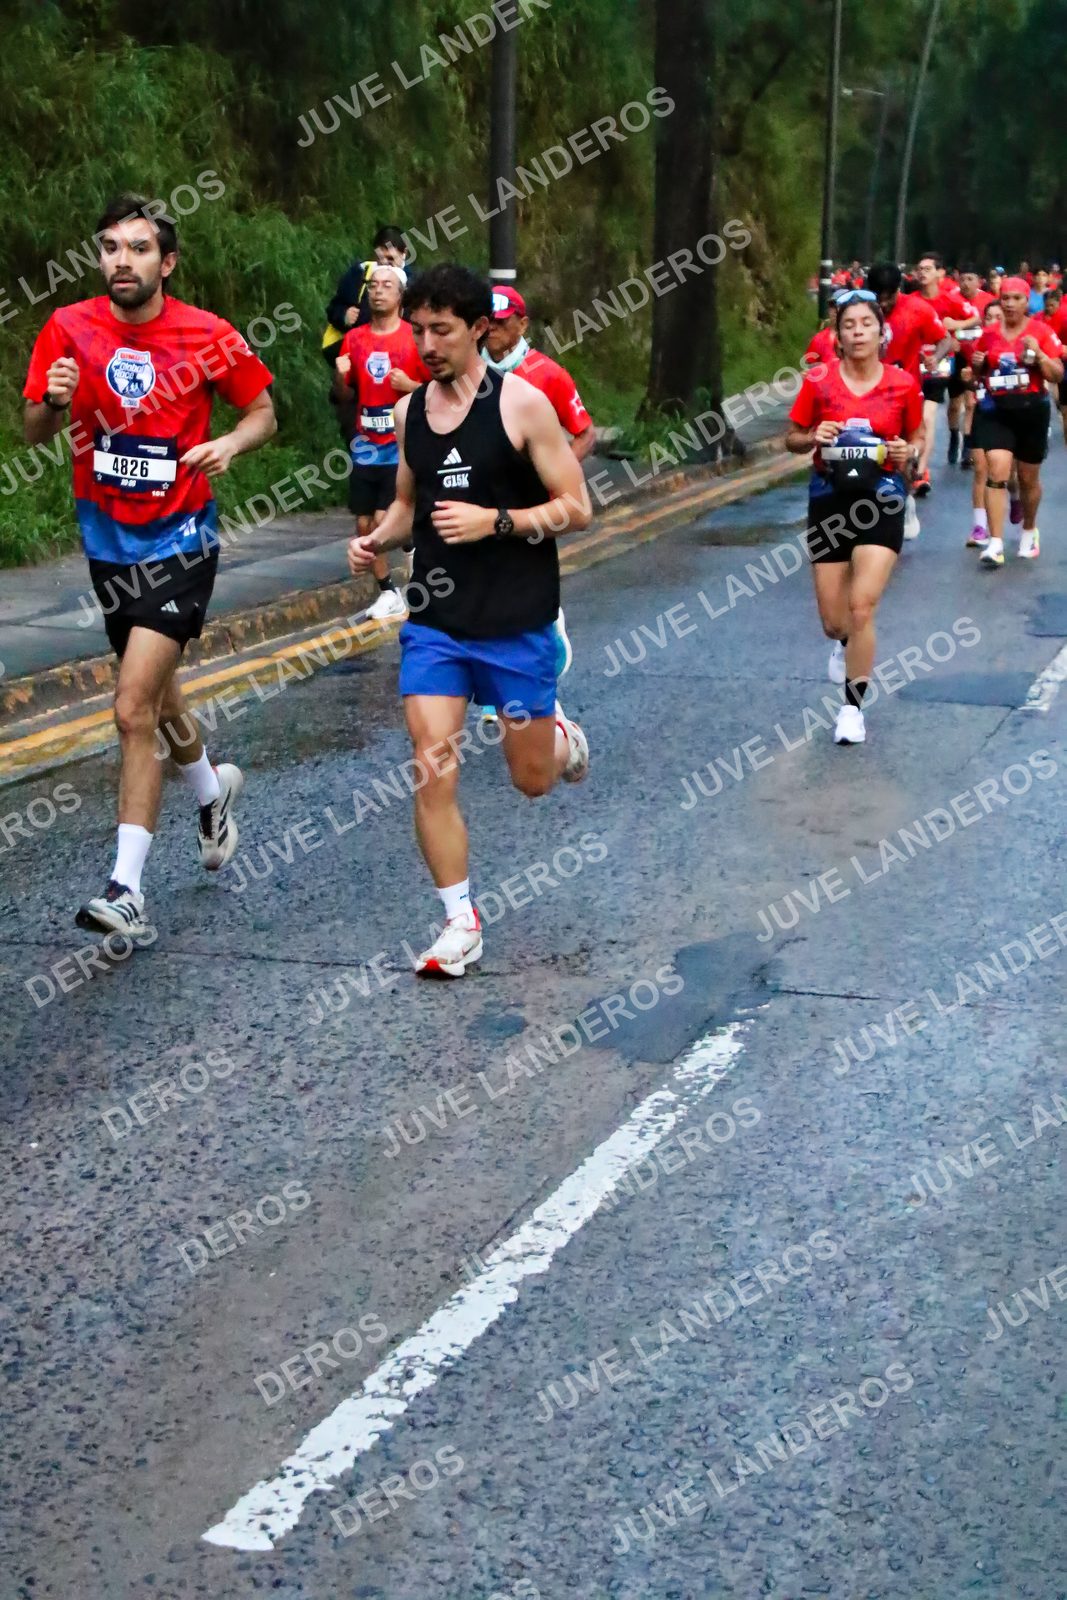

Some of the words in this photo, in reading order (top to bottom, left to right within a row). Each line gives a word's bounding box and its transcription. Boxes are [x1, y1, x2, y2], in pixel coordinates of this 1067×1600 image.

[114, 370, 134, 380] Race
[841, 448, 868, 459] 4024
[112, 457, 149, 478] 4826
[443, 473, 469, 488] G15K
